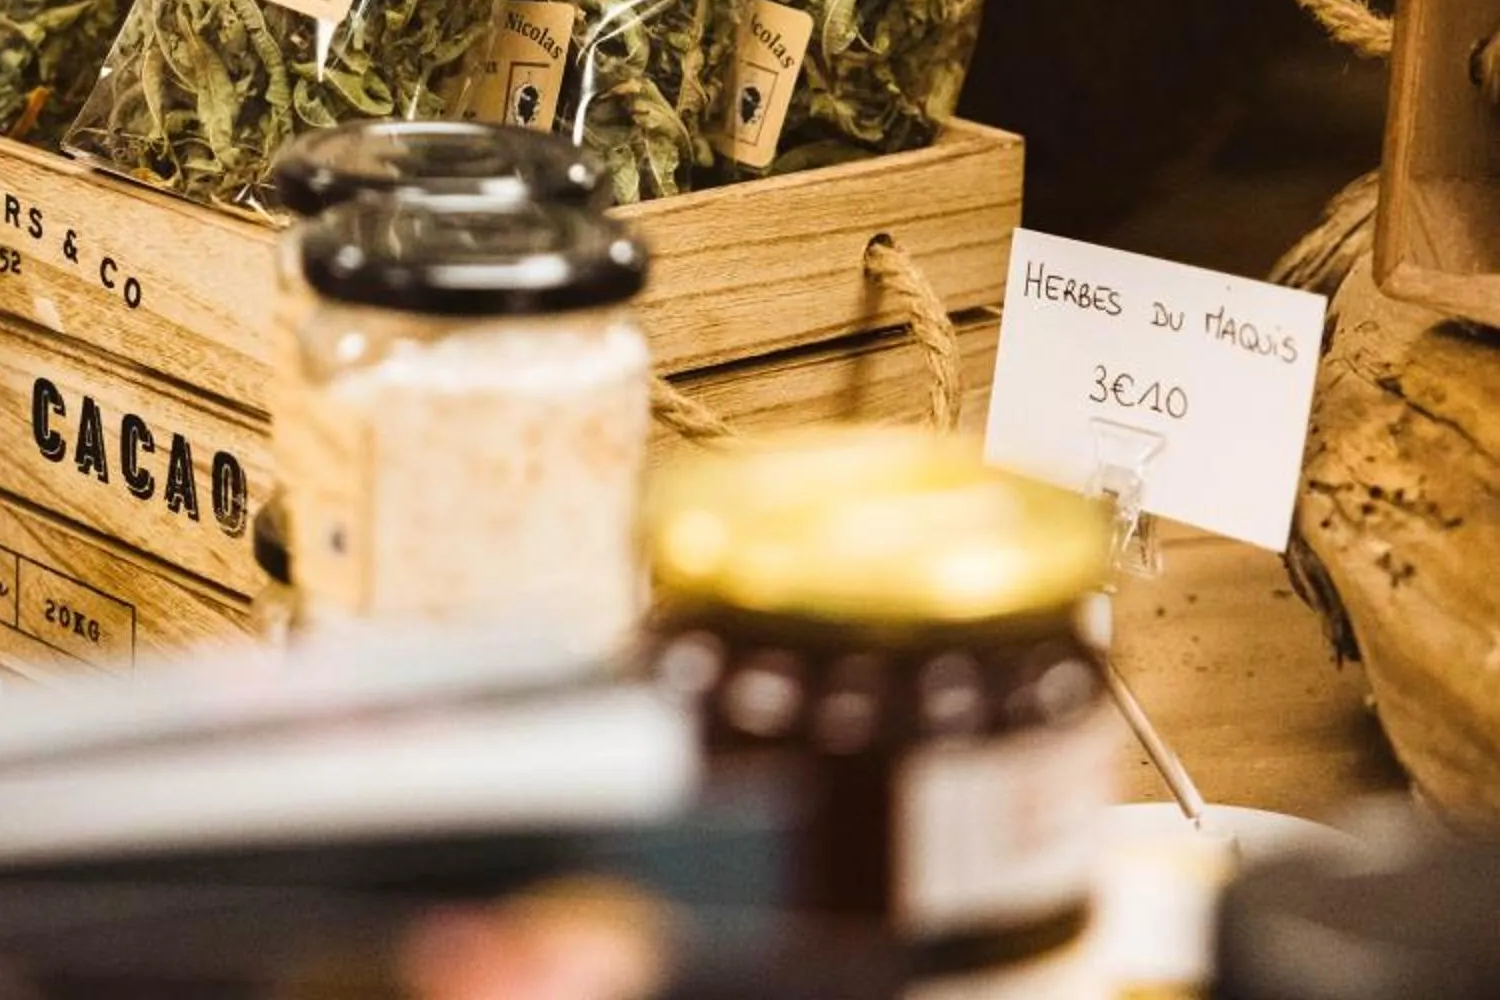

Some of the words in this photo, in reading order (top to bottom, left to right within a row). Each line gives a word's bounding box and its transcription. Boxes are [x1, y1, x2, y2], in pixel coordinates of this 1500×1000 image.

[505, 11, 563, 60] Nicolas
[62, 229, 80, 265] &
[99, 256, 143, 310] CO
[1023, 260, 1123, 317] HERBES
[1150, 301, 1186, 332] DU
[1204, 306, 1300, 365] MAQUIS
[1089, 364, 1189, 420] 3€10
[32, 376, 248, 539] CACAO
[44, 600, 101, 643] 20KG
